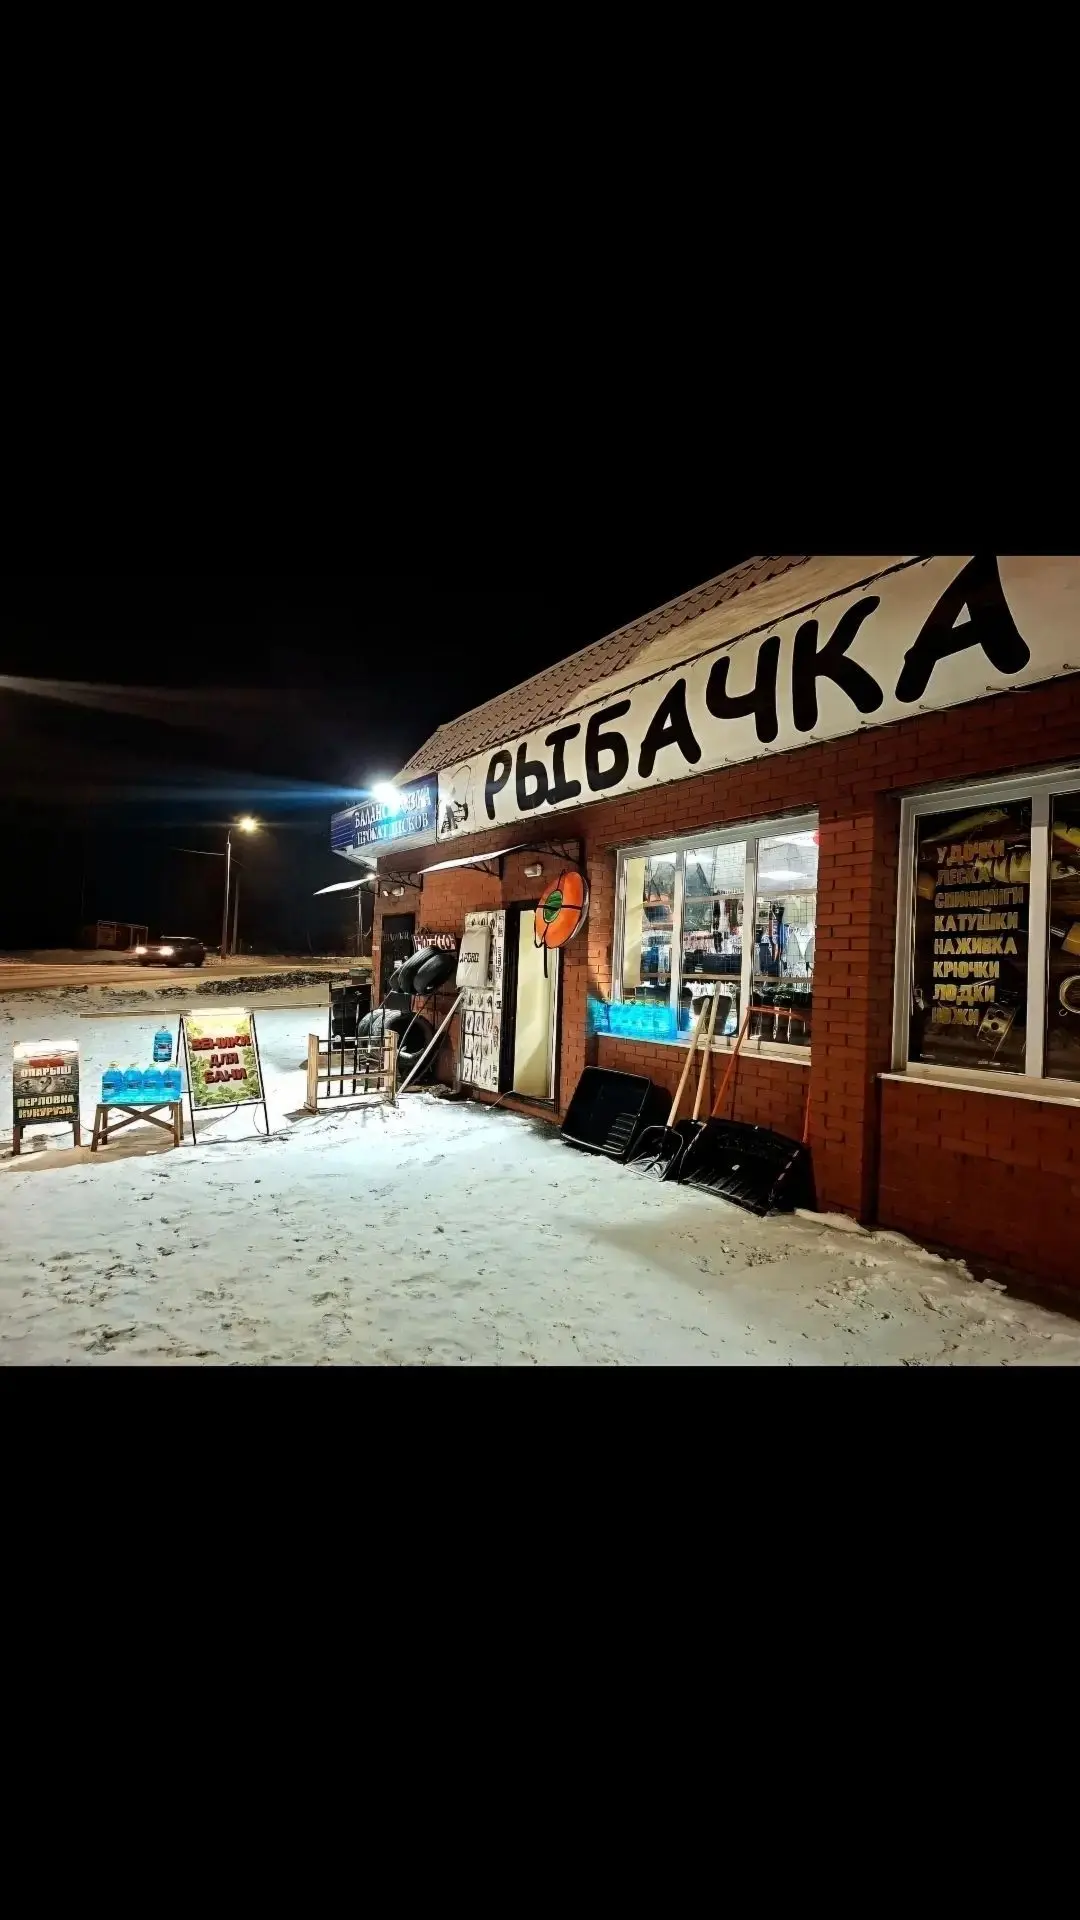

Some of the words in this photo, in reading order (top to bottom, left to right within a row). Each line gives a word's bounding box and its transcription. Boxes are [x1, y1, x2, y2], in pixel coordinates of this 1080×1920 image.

[484, 555, 1031, 820] РЫБАЧКА
[936, 840, 1004, 867] УДОЧКИ
[936, 866, 992, 886] ЛЕСКА
[934, 911, 1019, 932] КАТУШКИ
[933, 936, 1018, 955] НАЖИВКА
[932, 961, 1000, 979] КРЮЧКИ
[932, 984, 996, 1007] ЛОДКИ
[931, 1007, 980, 1026] НОЖИ
[191, 1035, 252, 1051] ВЕНИКИ
[209, 1053, 239, 1068] ДЛЯ
[20, 1065, 73, 1078] ОПАРЫШ
[204, 1068, 248, 1084] БАНИ
[16, 1094, 75, 1108] ПЕРЛОВКА
[18, 1105, 74, 1119] КУКУРУЗА
